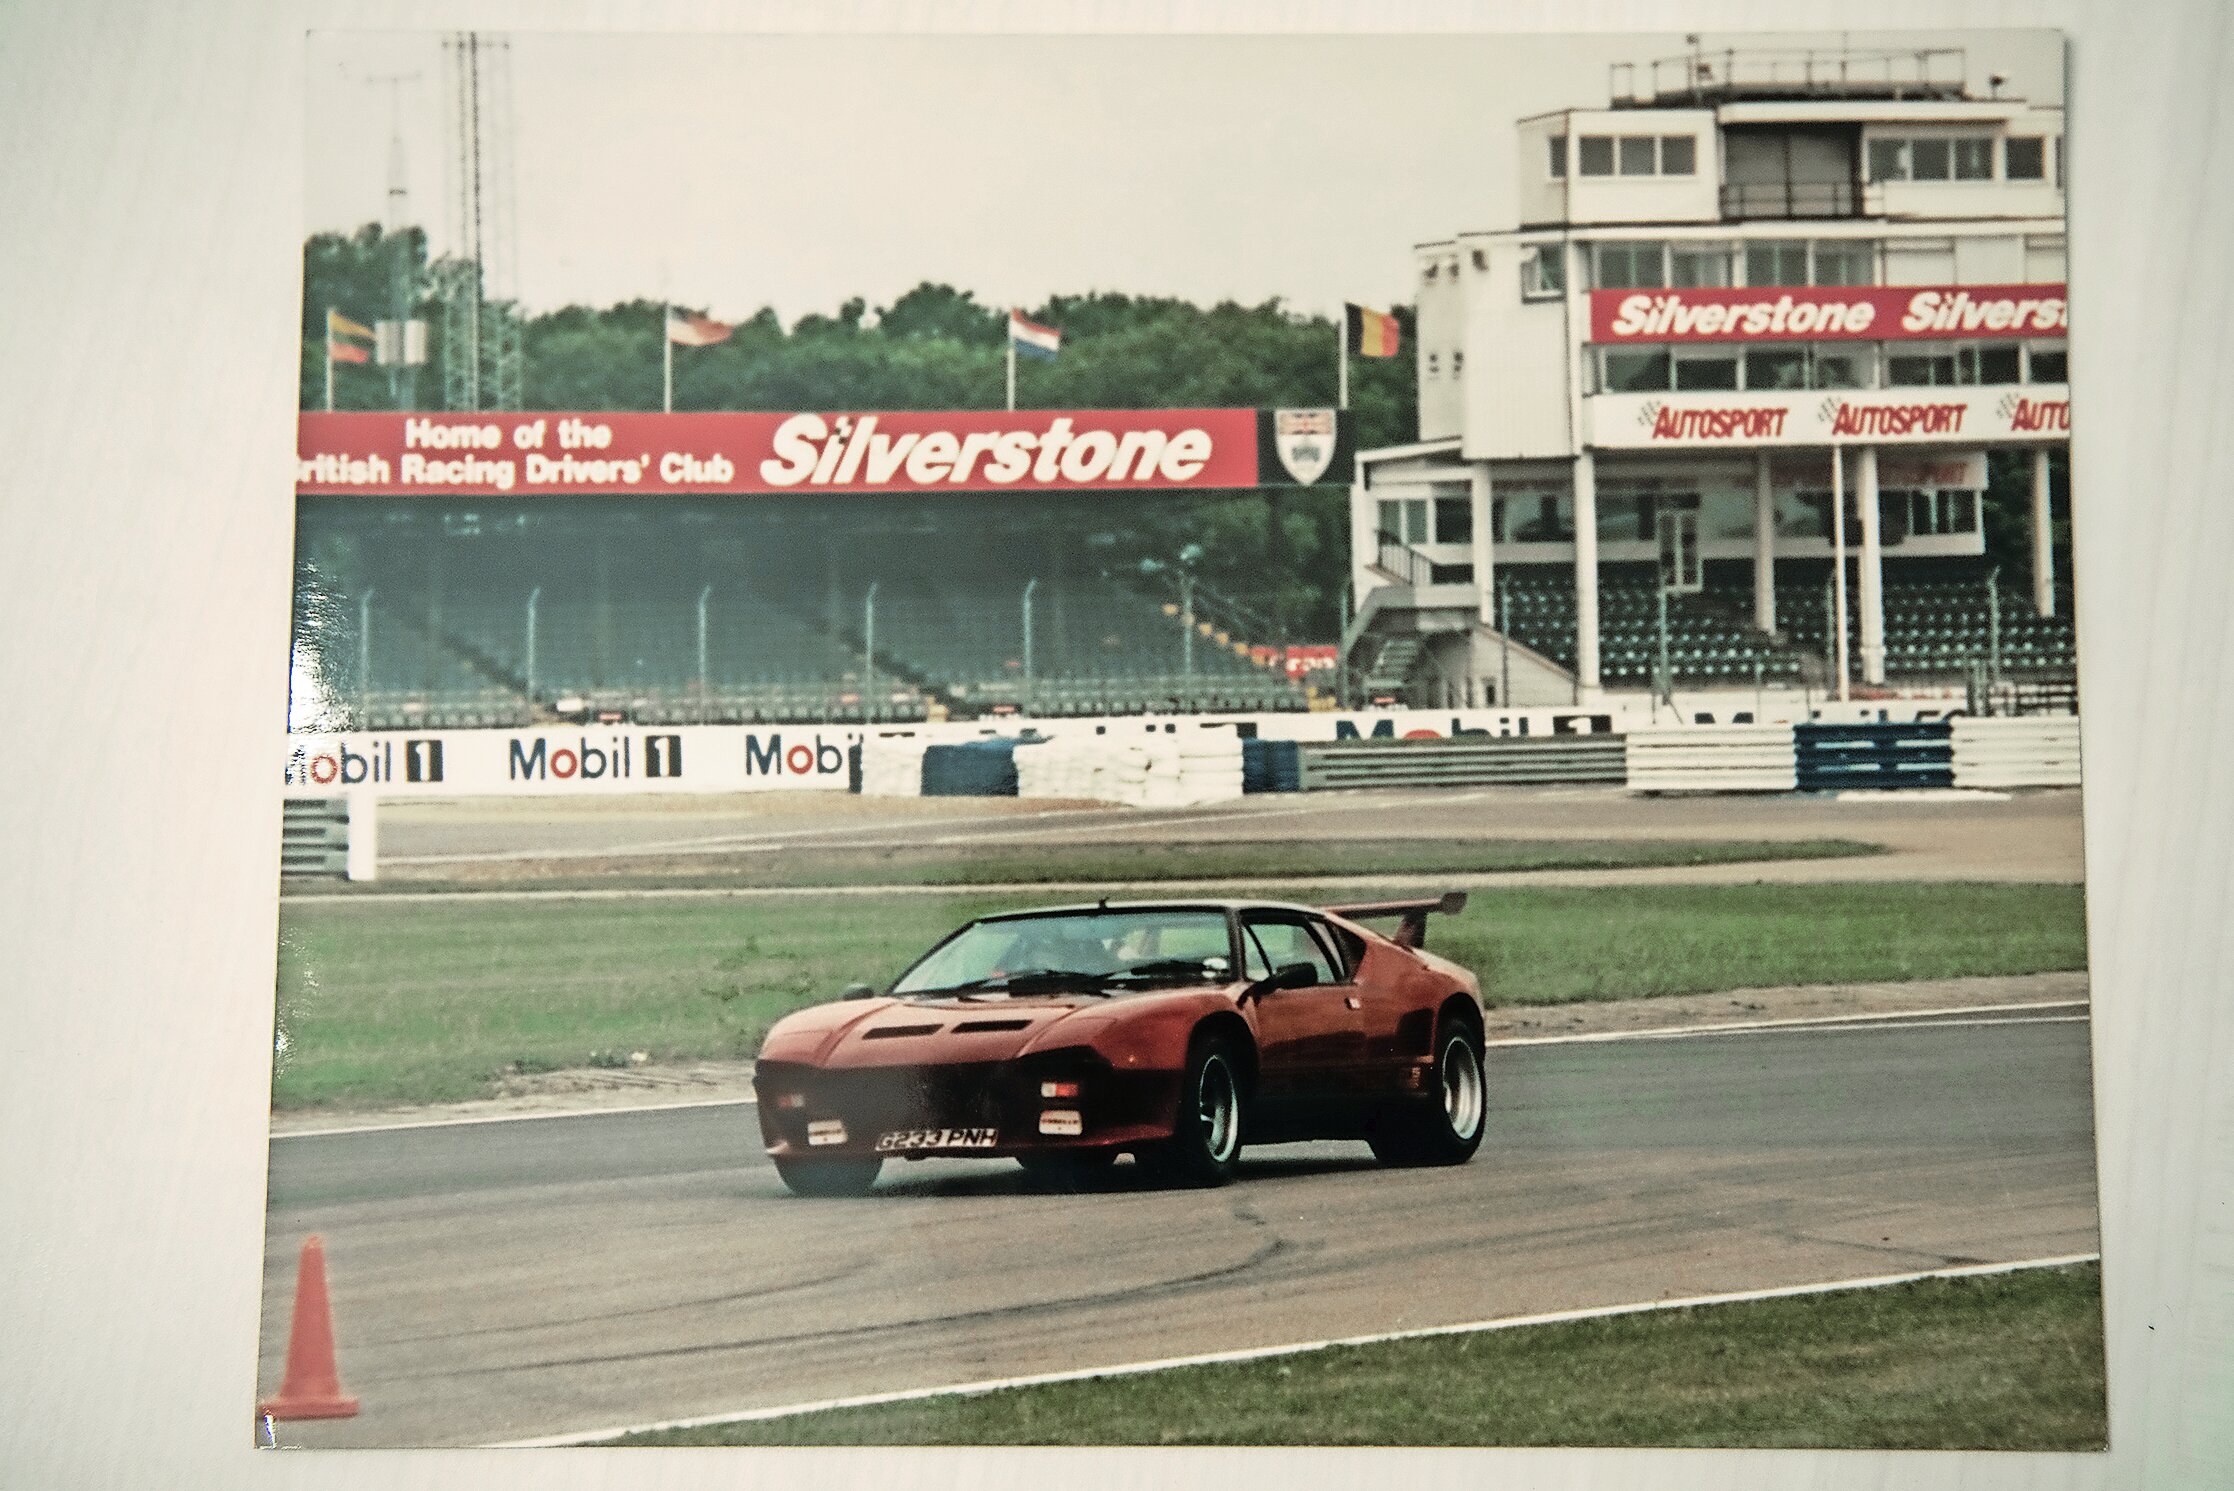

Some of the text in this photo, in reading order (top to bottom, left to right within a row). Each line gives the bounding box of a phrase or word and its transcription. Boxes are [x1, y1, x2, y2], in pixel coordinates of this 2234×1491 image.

[1612, 296, 1876, 336] Silverstone
[405, 418, 613, 450] Home of the
[1653, 405, 1789, 440] AUTOSPORT
[1832, 402, 1968, 437] AUTOSPORT
[759, 413, 1213, 487] Silverstone
[296, 451, 735, 490] ritish Racing Drivers' Club
[510, 735, 630, 780] Mobil
